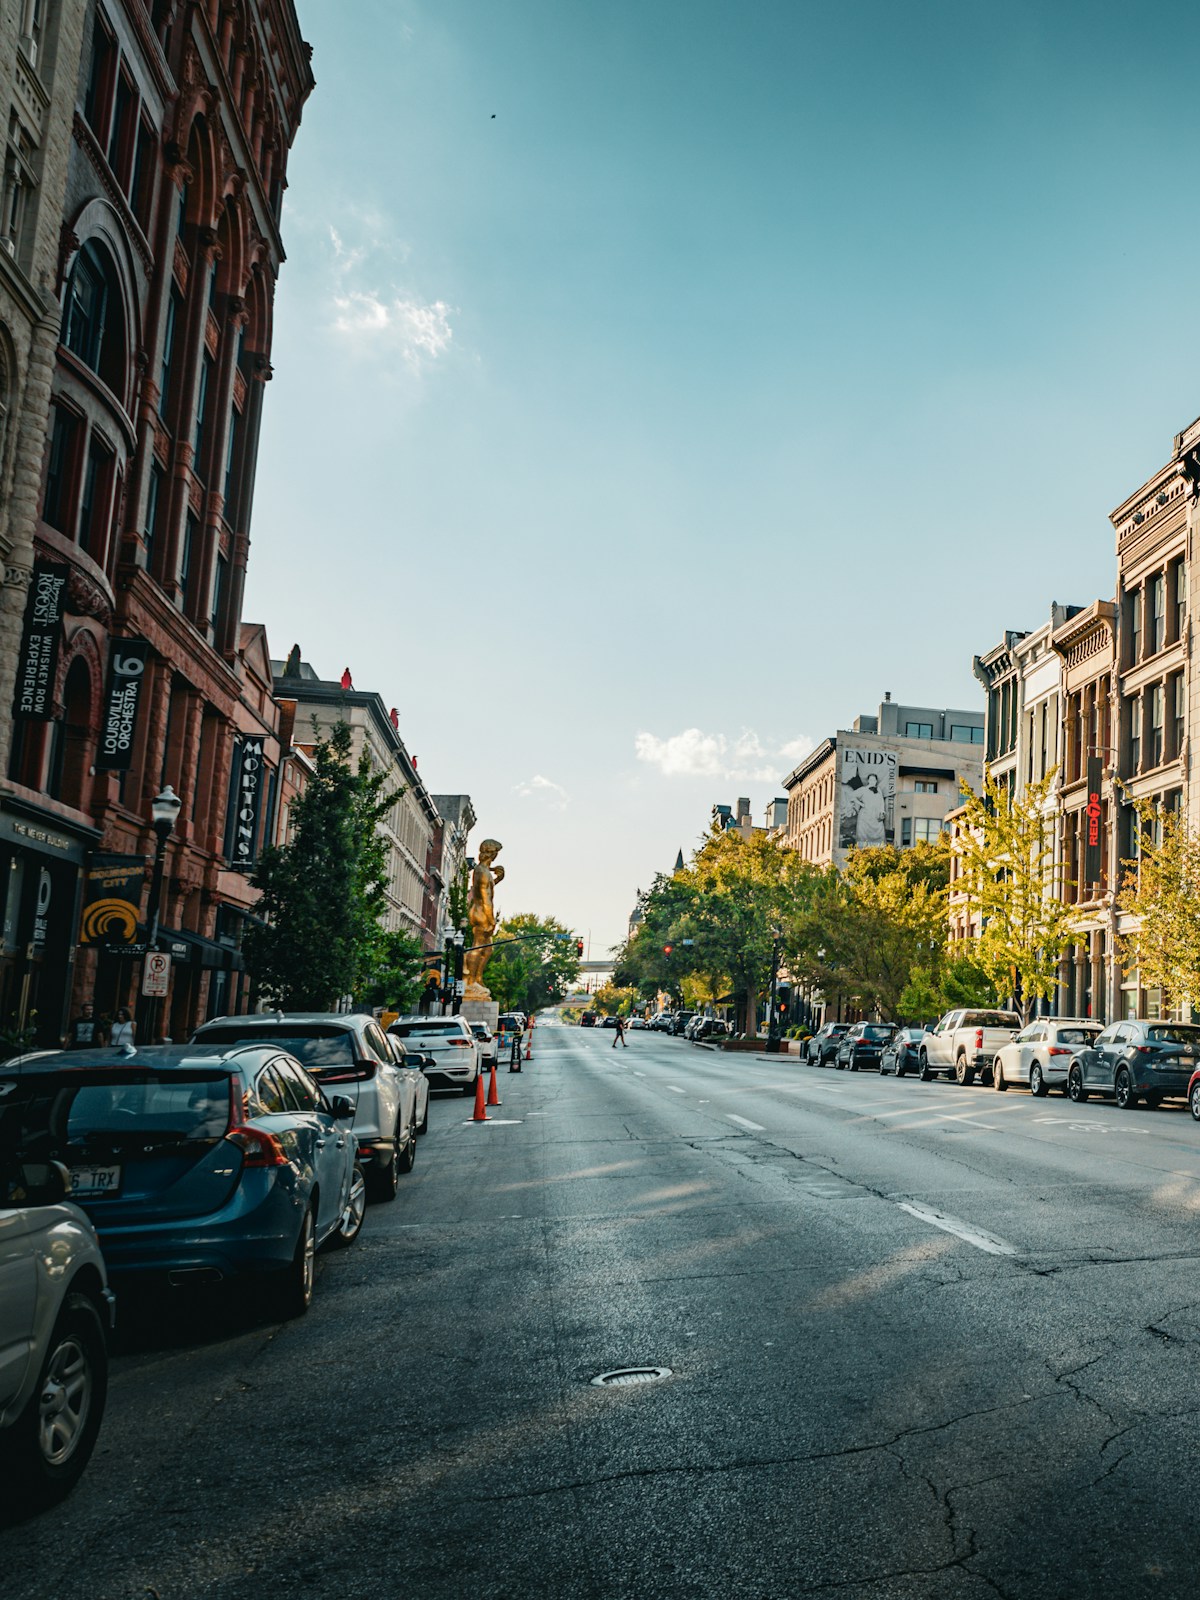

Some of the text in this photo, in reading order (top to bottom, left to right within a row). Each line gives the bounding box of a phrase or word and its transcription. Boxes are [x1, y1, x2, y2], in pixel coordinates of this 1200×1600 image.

[32, 572, 54, 627] ROOST
[47, 577, 65, 624] Buzzard's
[20, 634, 41, 712] EXPERIENCE
[34, 635, 53, 714] WHISKEY ROW
[103, 690, 124, 755] LOUISVILLE
[117, 681, 138, 750] ORCHESTRA
[845, 750, 896, 766] ENID'S
[13, 822, 26, 835] THE
[102, 877, 129, 888] CITY
[91, 1172, 115, 1188] TRX
